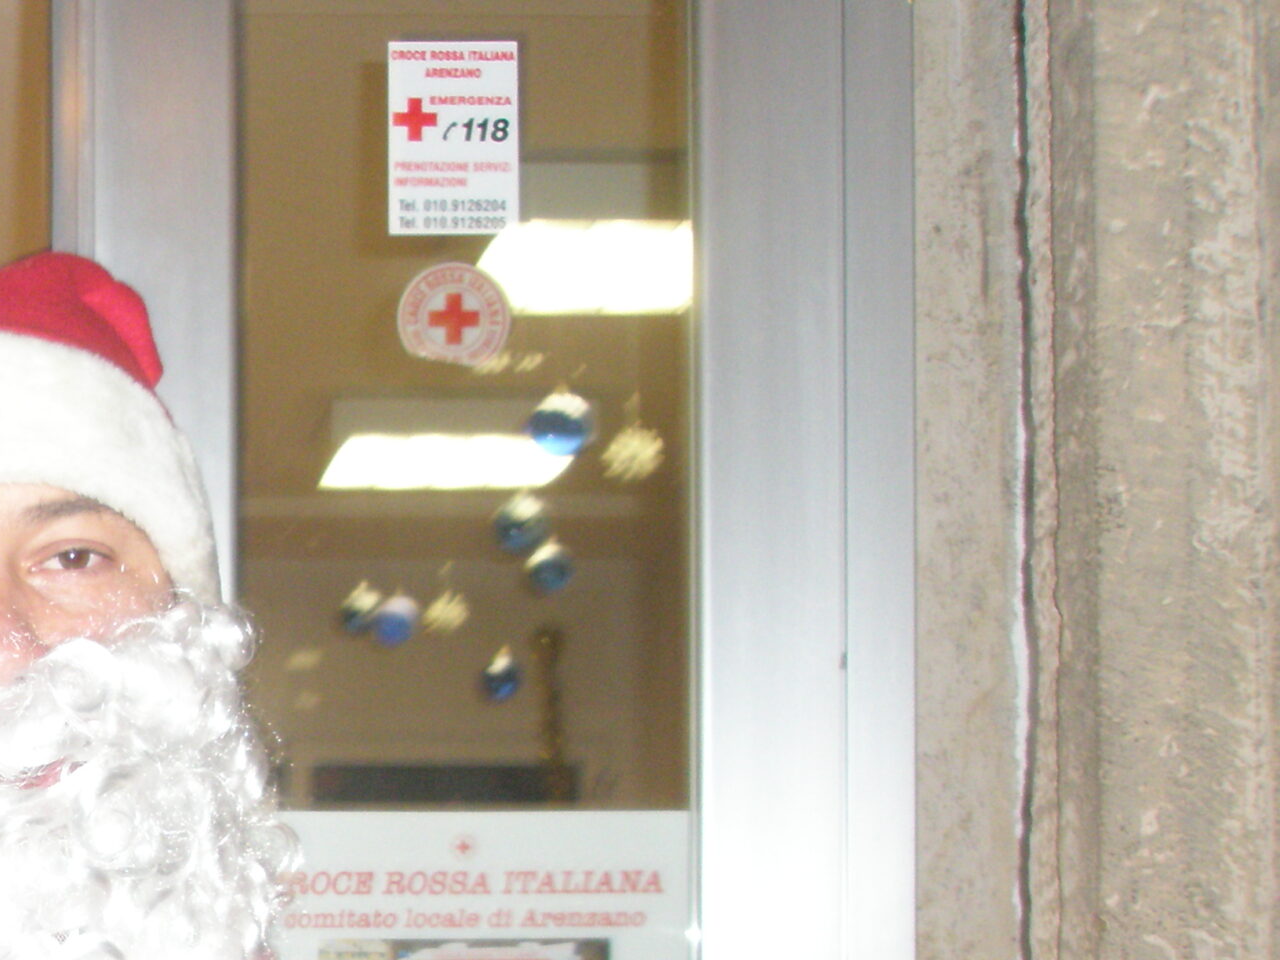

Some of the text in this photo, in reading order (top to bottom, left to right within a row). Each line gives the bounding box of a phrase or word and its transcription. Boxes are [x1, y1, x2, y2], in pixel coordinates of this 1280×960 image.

[391, 50, 515, 61] CROCE ROSSA ITALIANA
[425, 68, 482, 78] ARENZANO
[429, 96, 512, 106] EMERGENZA
[462, 117, 510, 142] 118
[398, 199, 419, 212] Tel.
[398, 216, 419, 229] Tel.
[382, 870, 491, 896] ROSSA
[503, 870, 664, 895] ITALIANA
[283, 908, 648, 929] comitato locale di Arenzano
